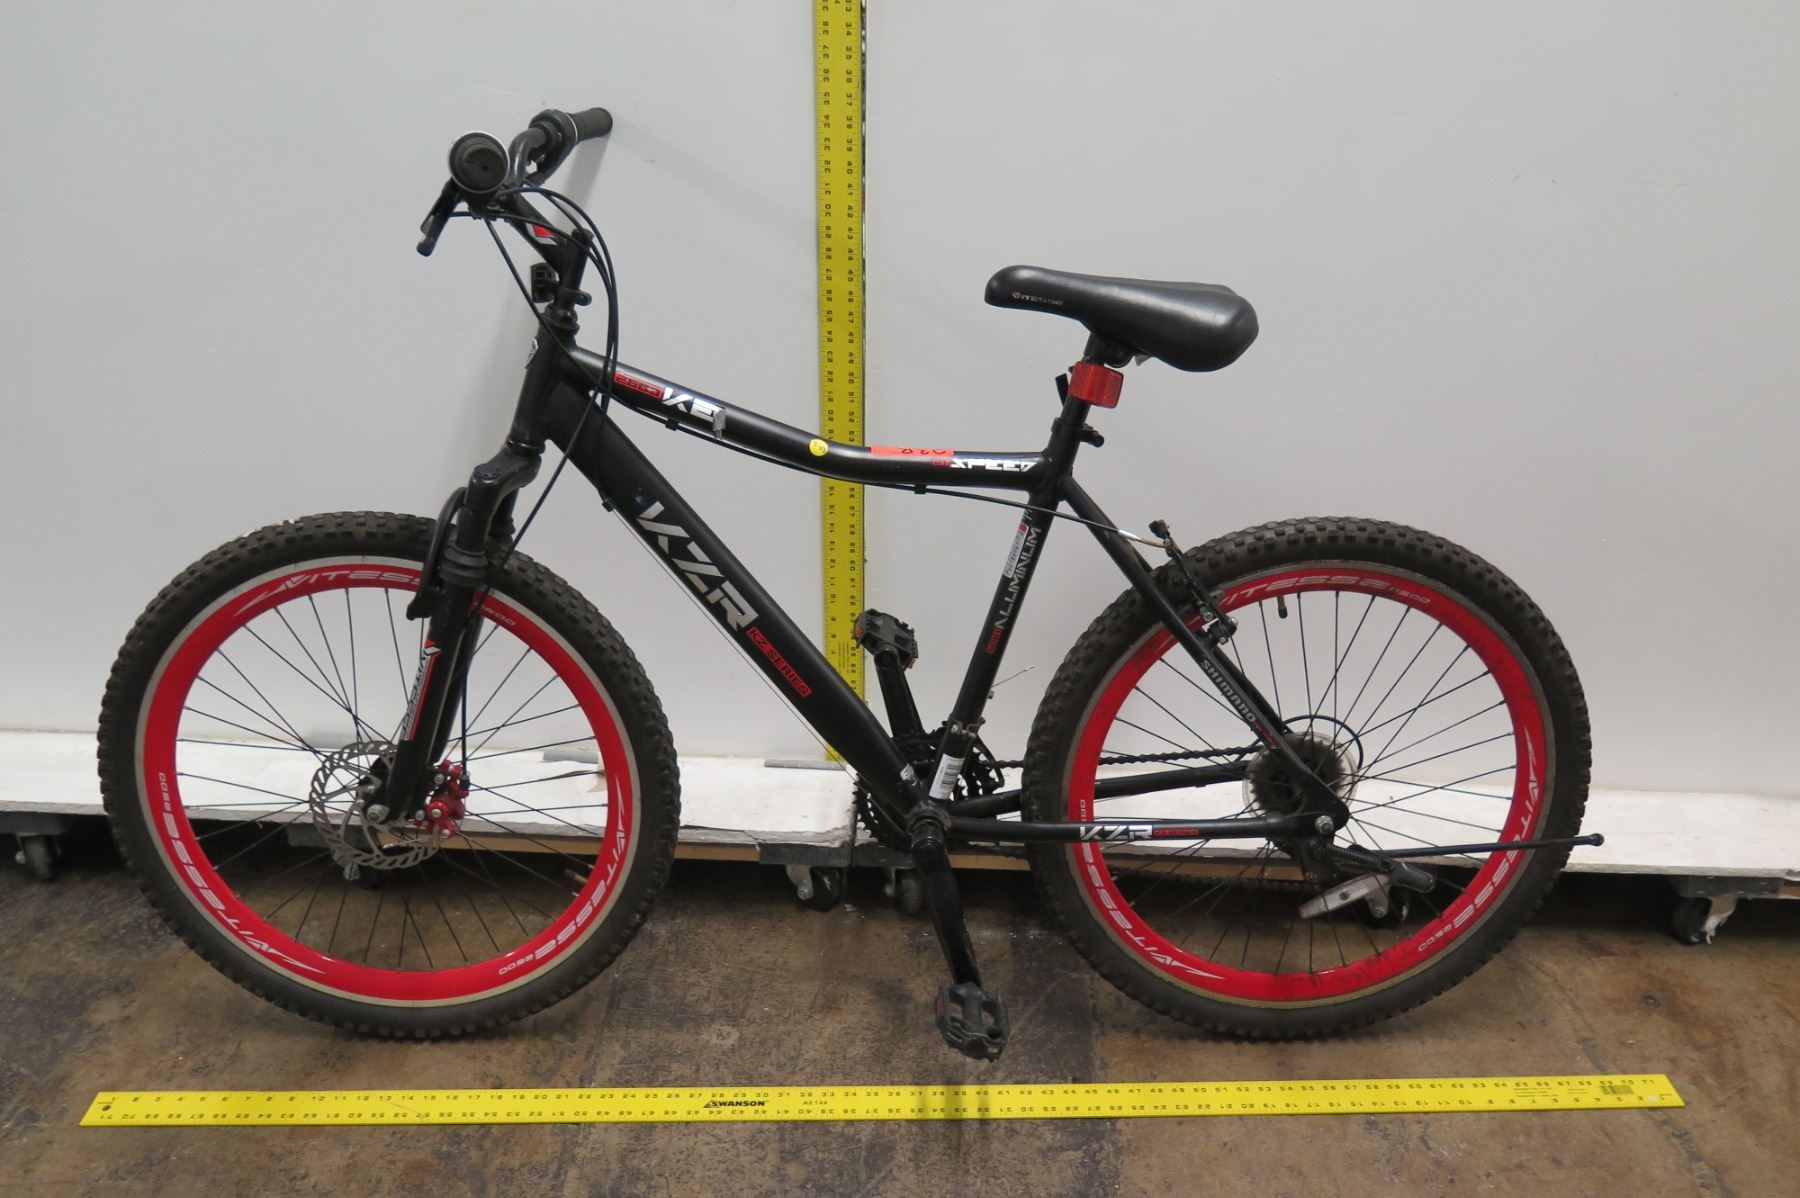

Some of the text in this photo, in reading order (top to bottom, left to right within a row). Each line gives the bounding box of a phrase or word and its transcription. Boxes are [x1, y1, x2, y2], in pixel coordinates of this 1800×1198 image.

[949, 458, 1038, 473] SPEED
[637, 501, 759, 631] KZR
[767, 649, 812, 697] SERIES
[1080, 825, 1153, 841] KZR
[535, 818, 626, 961] VITESSE
